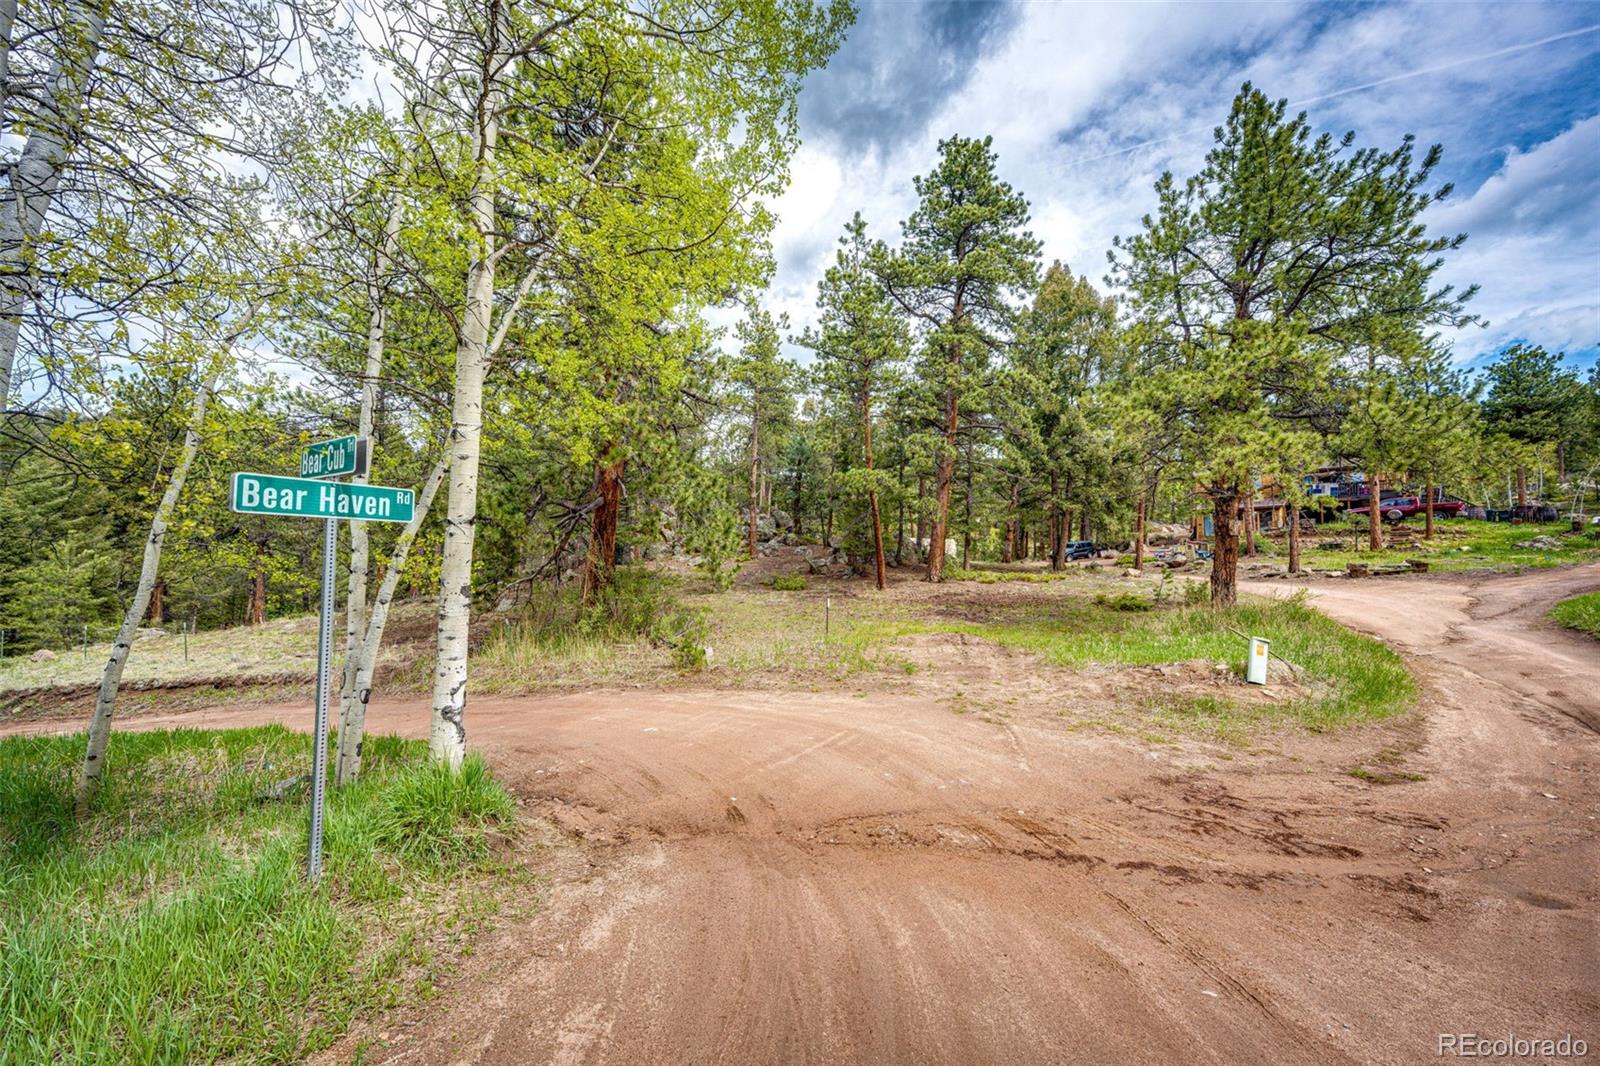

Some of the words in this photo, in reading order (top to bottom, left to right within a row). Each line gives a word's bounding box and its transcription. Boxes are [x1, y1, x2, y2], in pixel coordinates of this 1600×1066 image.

[302, 451, 323, 475] Bear
[326, 444, 345, 471] Cub
[241, 479, 307, 510] Bear
[319, 486, 390, 516] Haven
[396, 491, 410, 505] Rd
